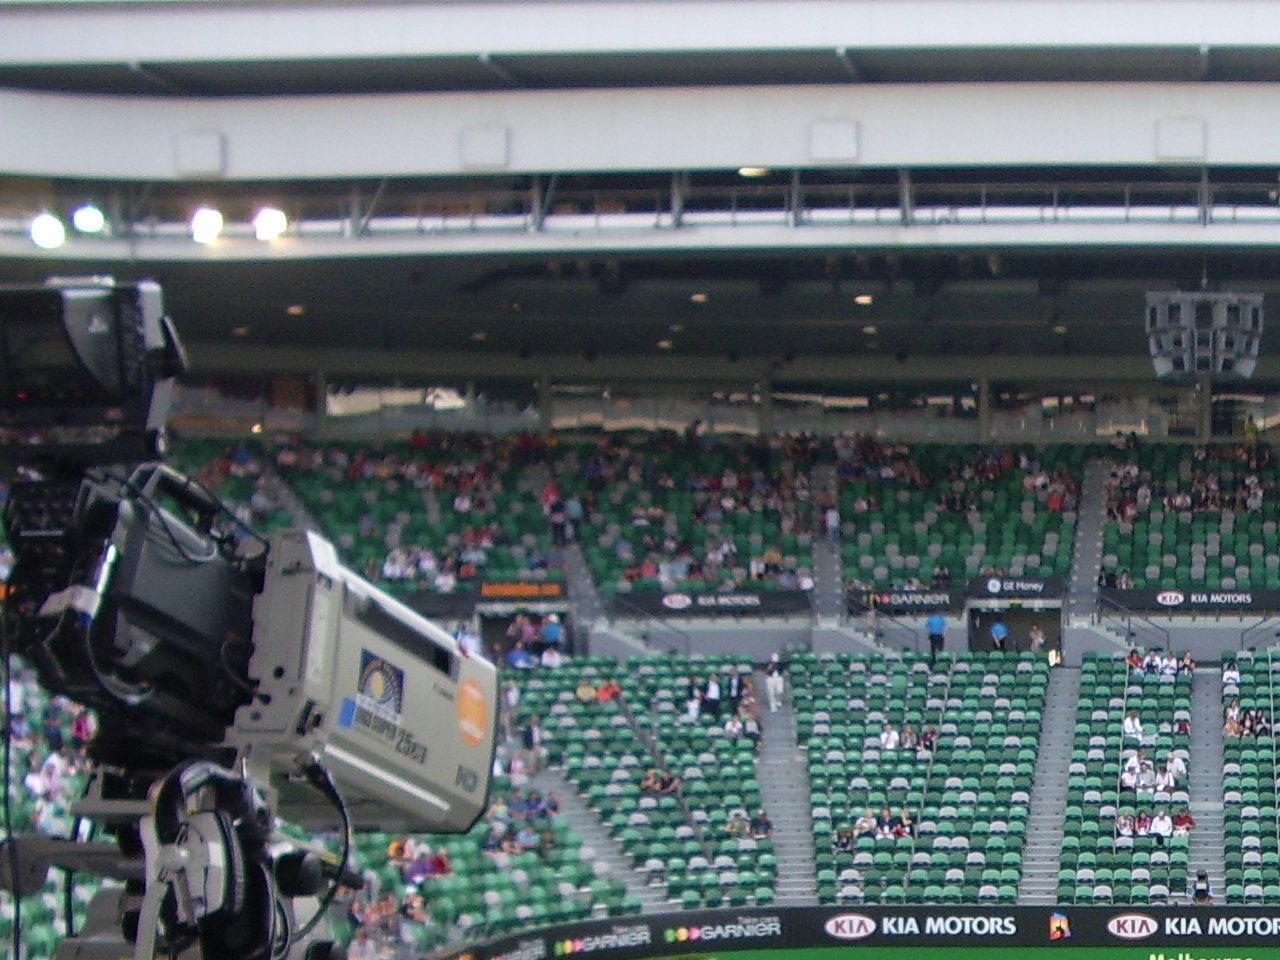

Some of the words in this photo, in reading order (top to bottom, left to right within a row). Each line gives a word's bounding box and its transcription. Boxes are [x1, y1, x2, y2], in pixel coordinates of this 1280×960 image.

[1191, 593, 1207, 603] KIA
[1210, 593, 1252, 604] MOTORS
[699, 924, 781, 940] GARNIER
[834, 922, 869, 934] KIA
[882, 917, 920, 935] KIA
[925, 917, 1017, 935] MOTORS
[1116, 922, 1150, 934] KIA
[1165, 917, 1202, 935] KIA
